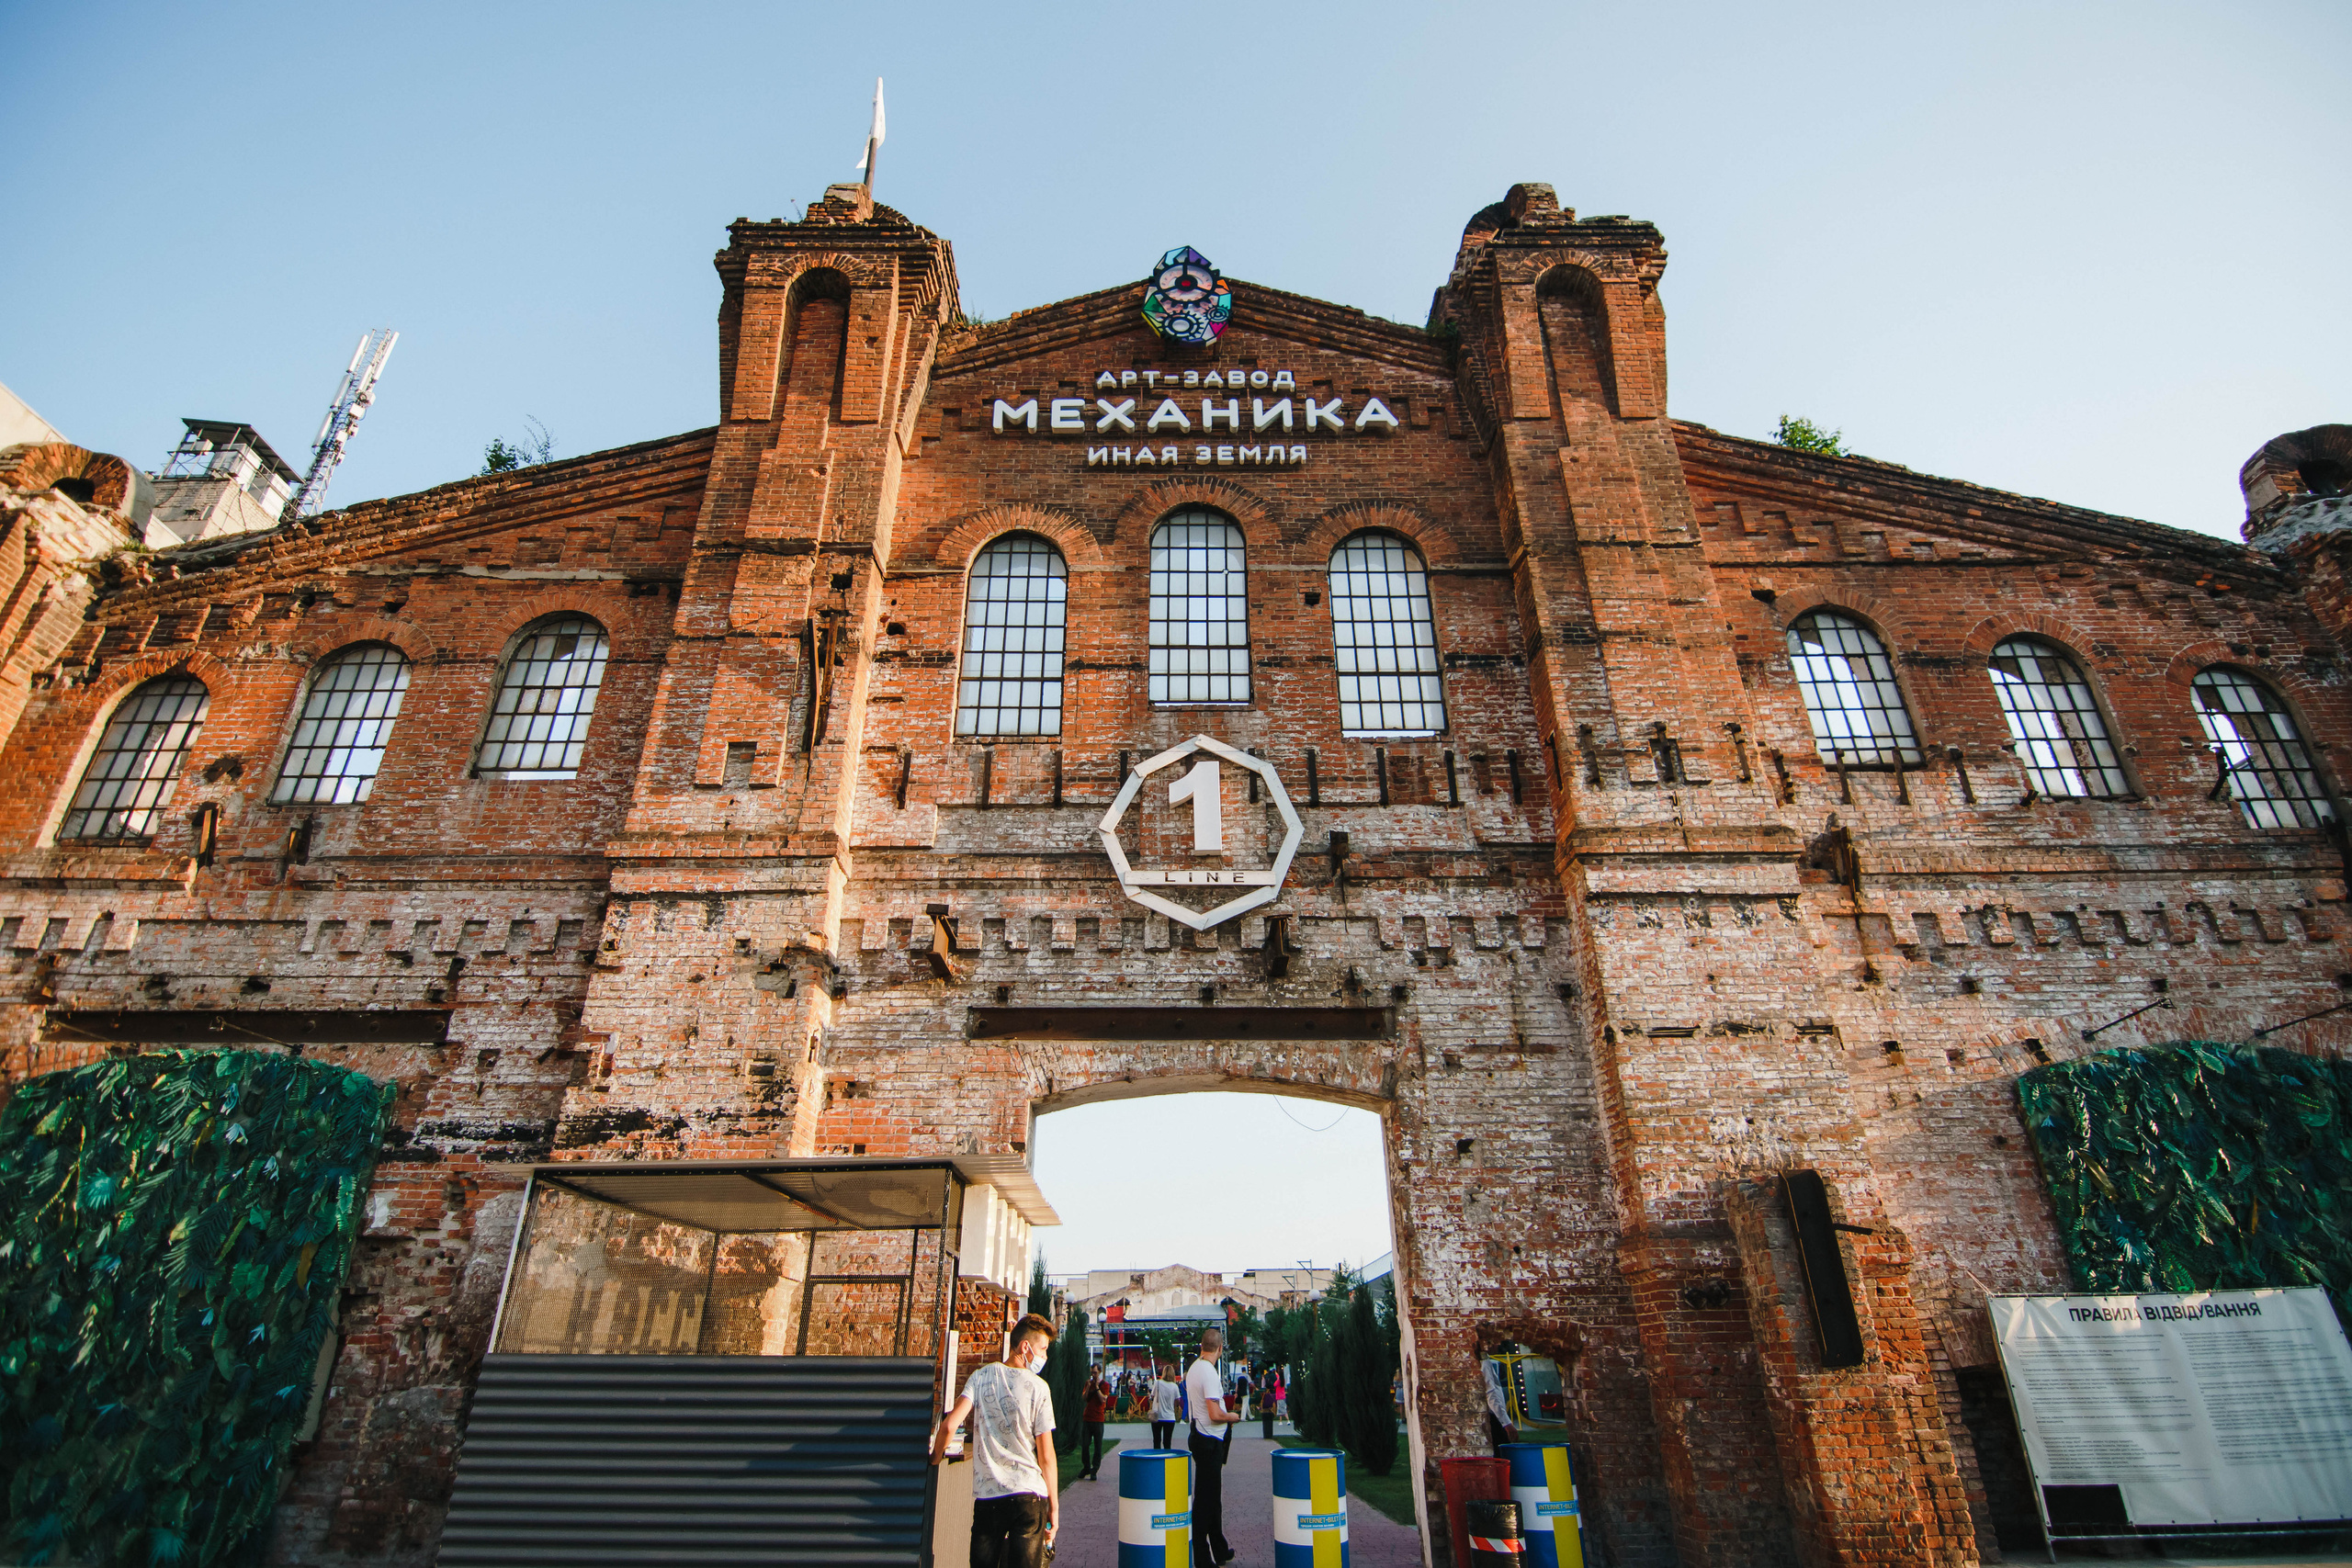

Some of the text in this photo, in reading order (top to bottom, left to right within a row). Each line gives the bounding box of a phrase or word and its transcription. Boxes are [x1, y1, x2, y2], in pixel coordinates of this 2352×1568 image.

[1097, 370, 1295, 392] АРТ-ЗАВОД
[992, 398, 1399, 434] МЕХАНИКА
[1088, 445, 1306, 467] ИНАЯ ЗЕМЛЯ
[1169, 761, 1223, 856] 1
[1164, 872, 1245, 883] LINE
[2068, 1302, 2262, 1322] ПРАВИЛА ВІДВІДУВАННЯ
